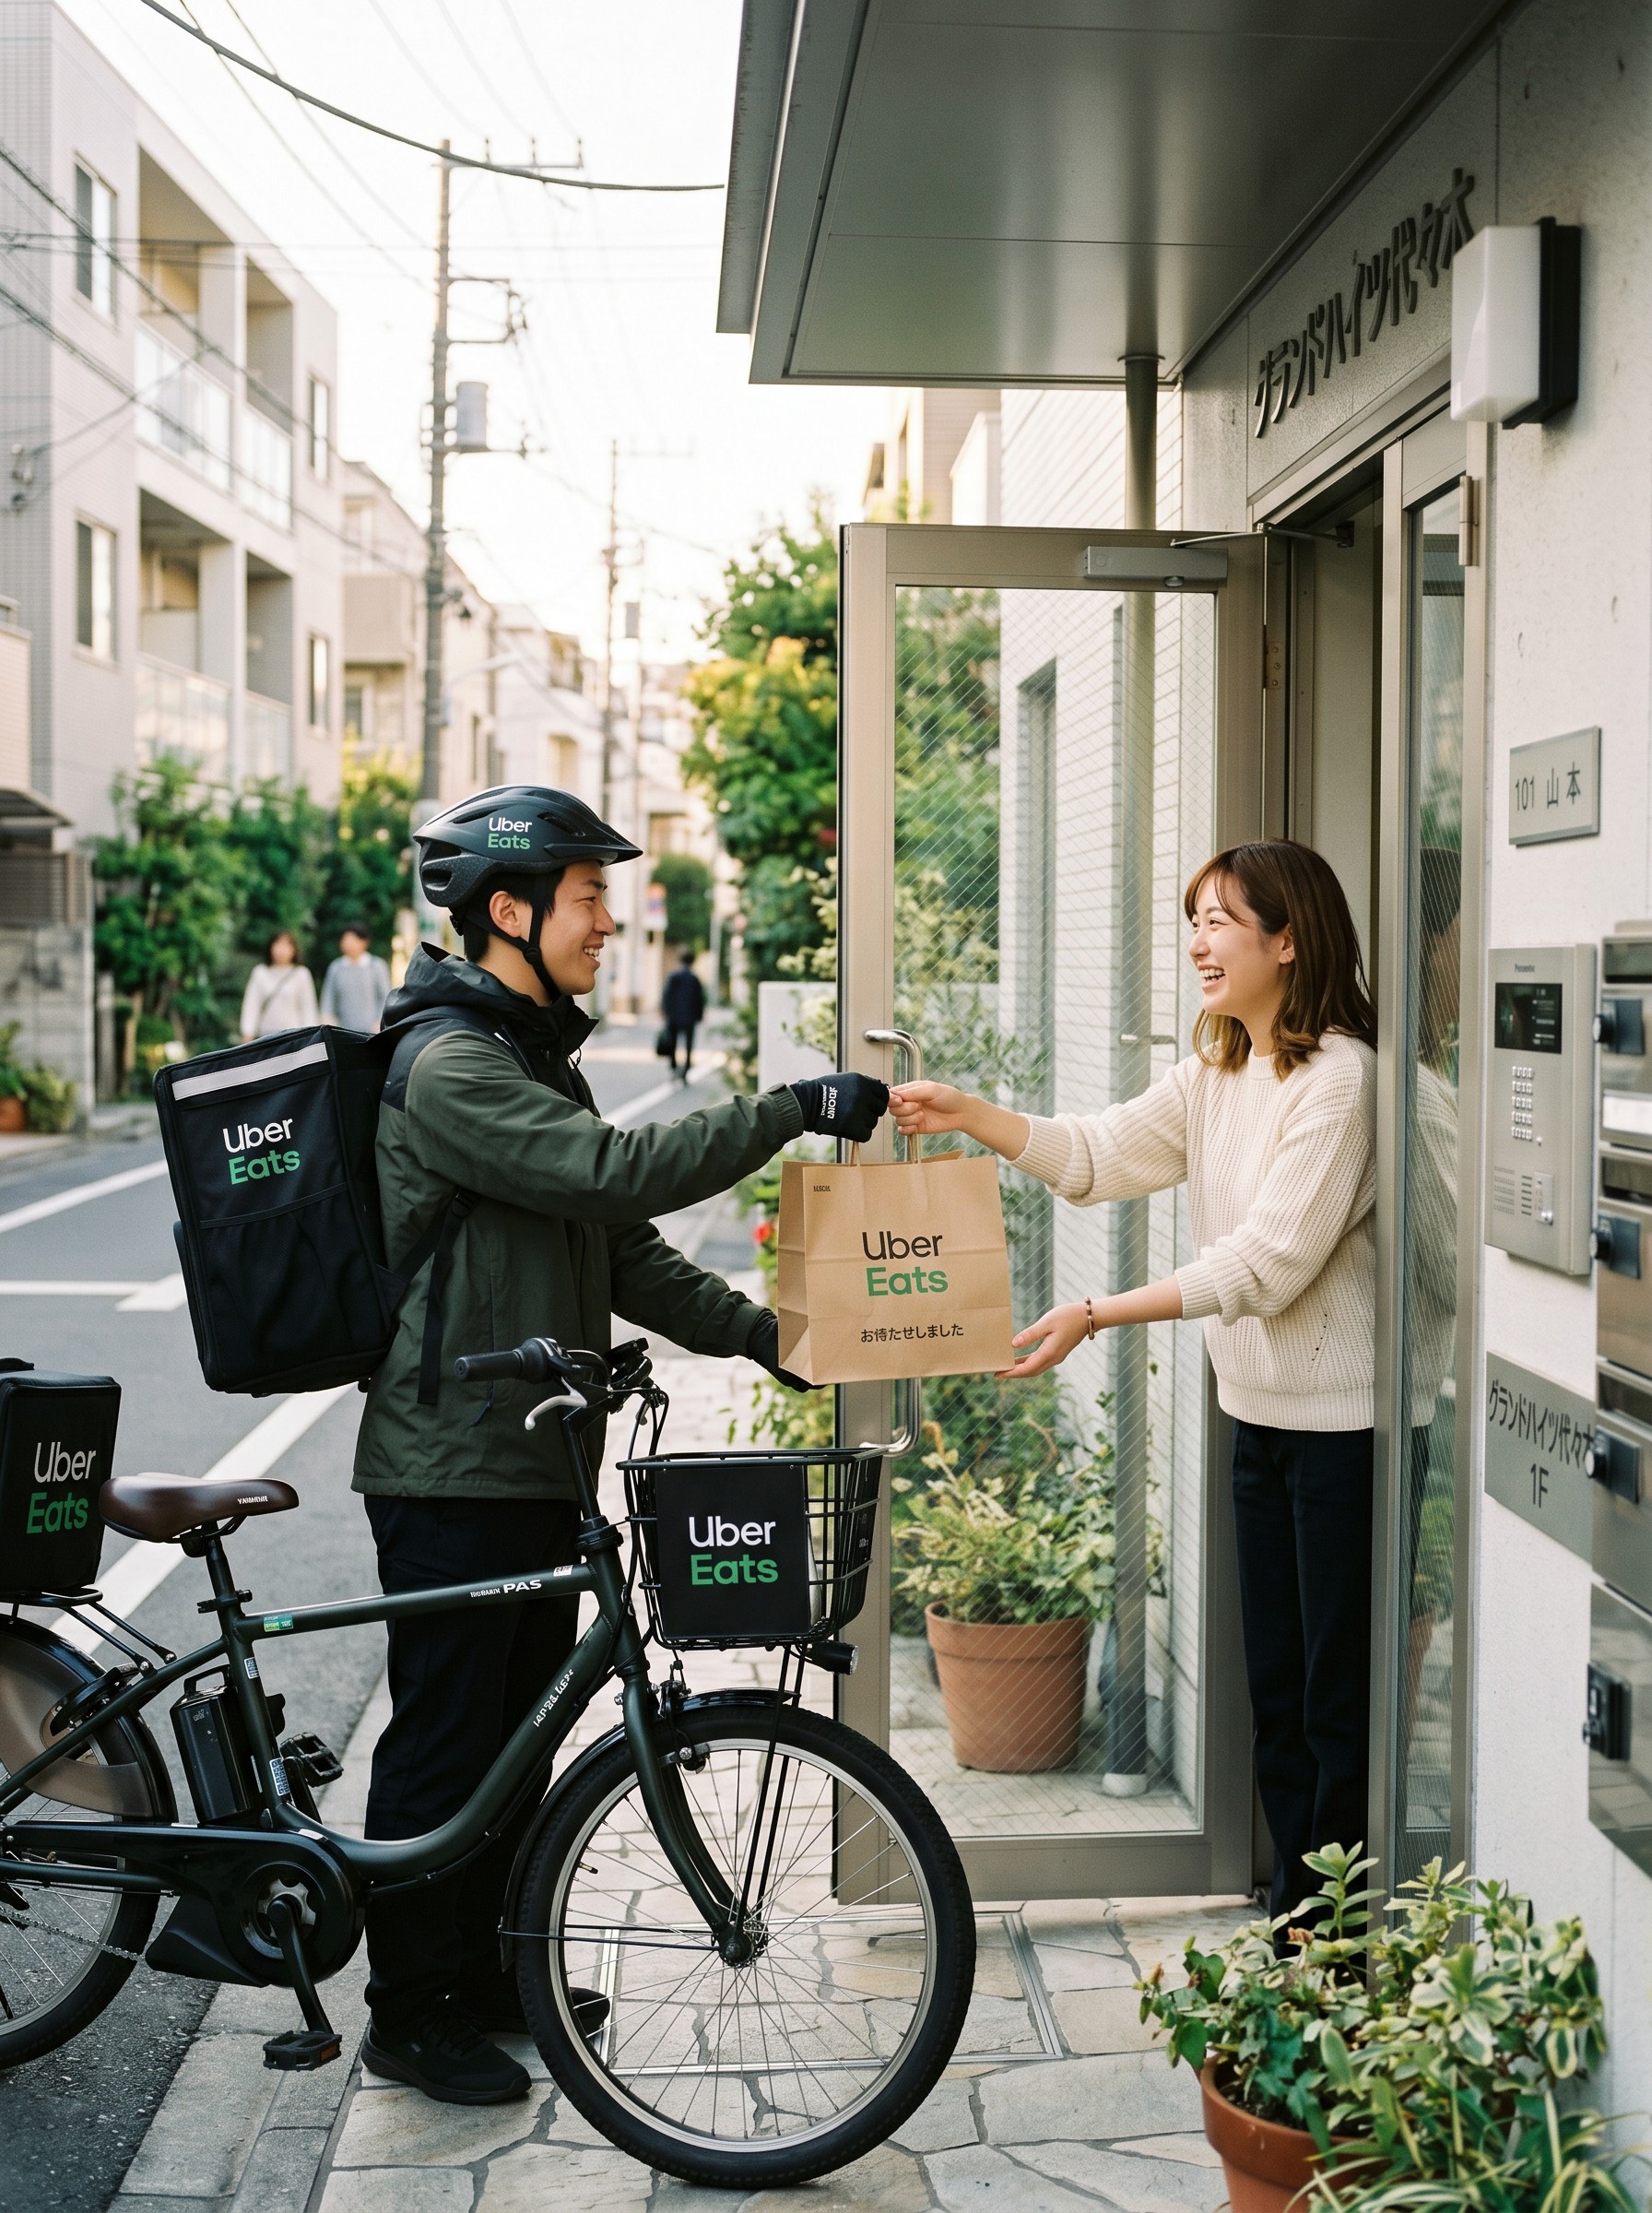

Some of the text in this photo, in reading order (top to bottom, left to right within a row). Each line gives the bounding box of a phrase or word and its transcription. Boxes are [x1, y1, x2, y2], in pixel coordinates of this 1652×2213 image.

[1515, 775, 1535, 811] 101
[489, 817, 533, 833] Uber
[488, 833, 531, 850] Eats
[222, 1118, 293, 1153] Uber
[228, 1150, 301, 1185] Eats
[862, 1230, 943, 1260] Uber
[866, 1266, 949, 1296] Eats
[860, 1323, 964, 1343] お待たせしました
[33, 1441, 97, 1484] Uber
[1530, 1462, 1550, 1509] 1F
[26, 1492, 89, 1534] Eats
[688, 1515, 776, 1548] Uber
[690, 1554, 779, 1586] Eats
[502, 1579, 542, 1594] PAS
